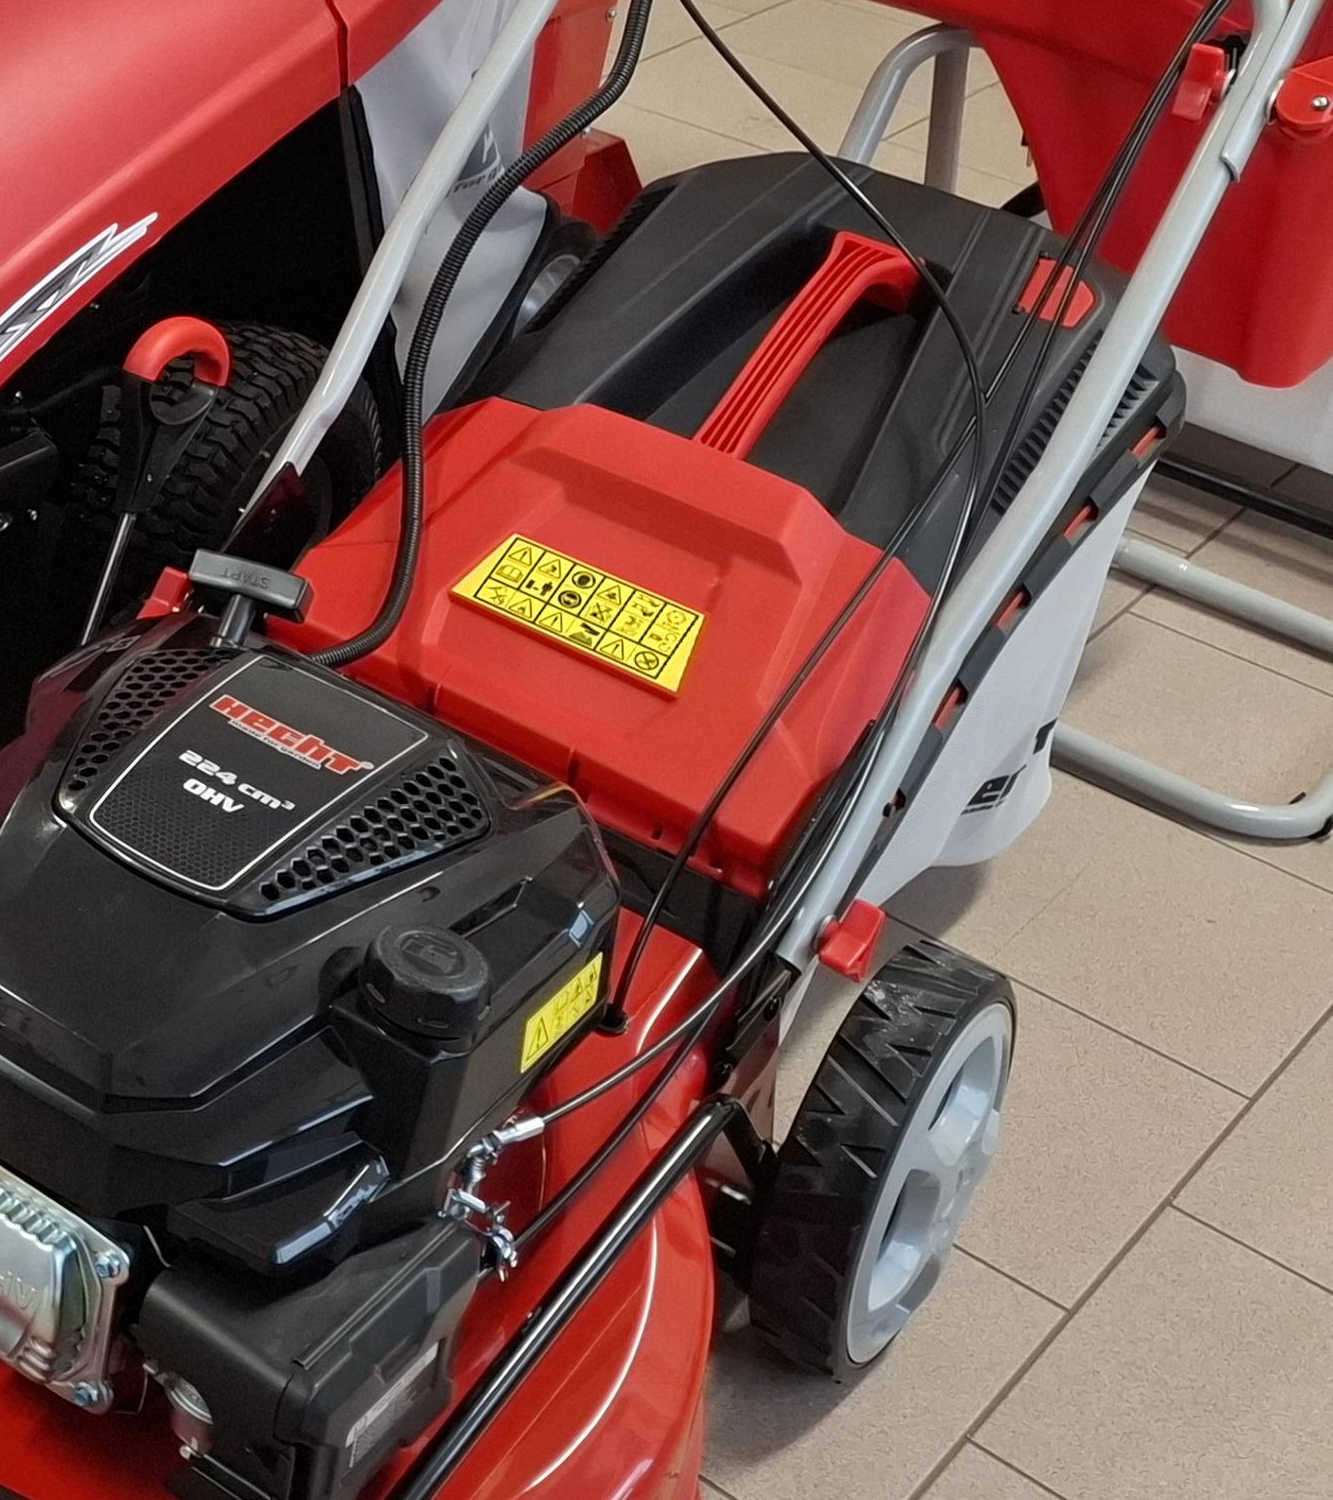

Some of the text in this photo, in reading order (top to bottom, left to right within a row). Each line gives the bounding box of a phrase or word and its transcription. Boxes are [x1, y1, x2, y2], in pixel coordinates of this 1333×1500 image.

[221, 566, 271, 590] START
[179, 749, 238, 786] 224
[182, 778, 245, 814] OHV
